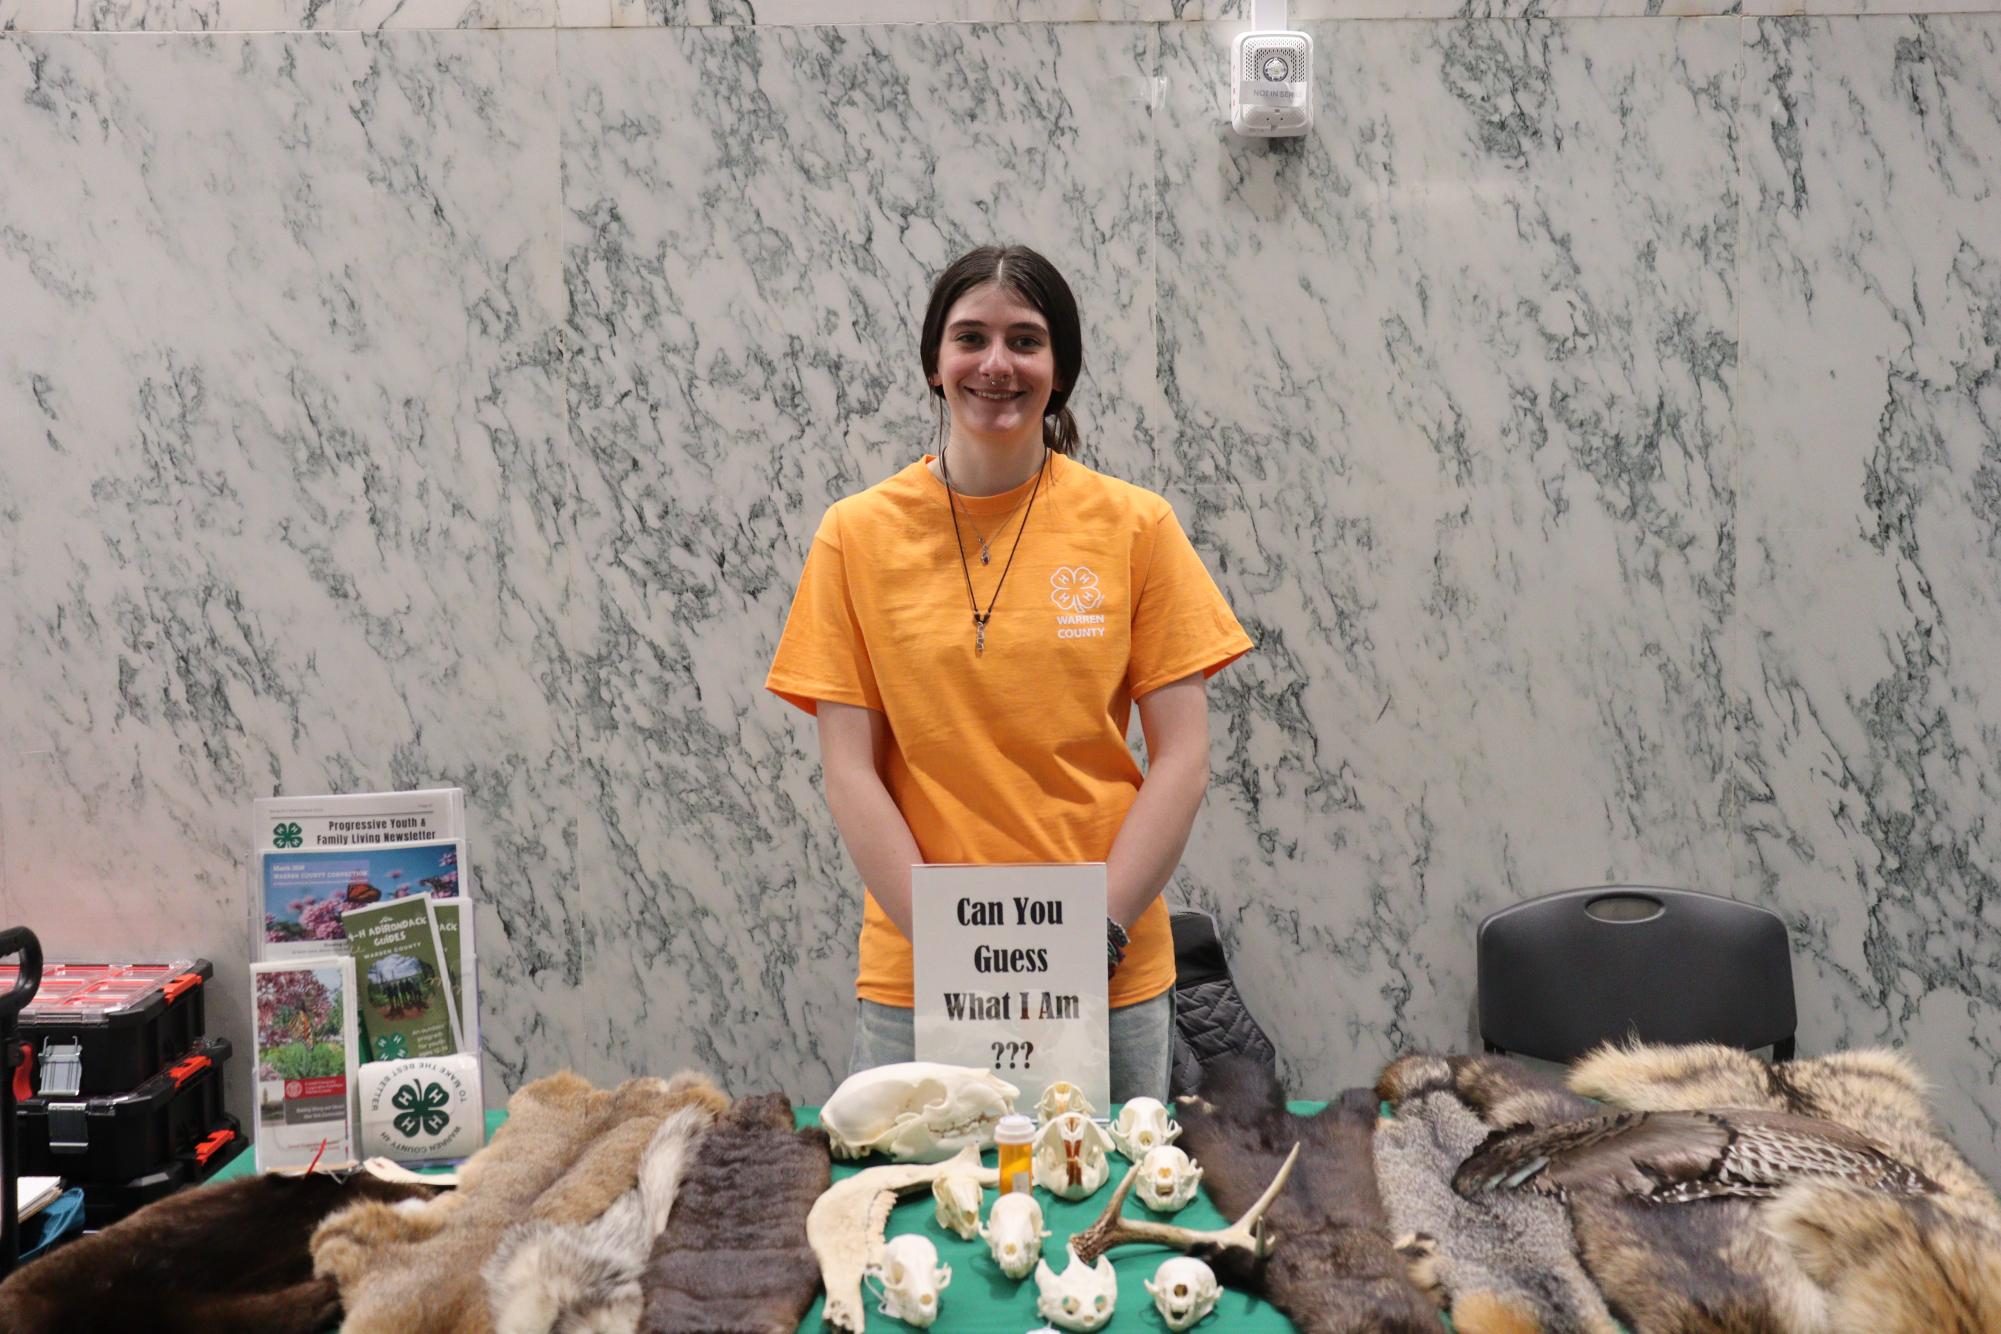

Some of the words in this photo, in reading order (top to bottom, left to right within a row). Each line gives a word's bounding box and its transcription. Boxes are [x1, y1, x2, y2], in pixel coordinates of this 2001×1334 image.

[1056, 615, 1104, 625] WARREN
[1057, 627, 1105, 639] COUNTY
[328, 819, 387, 832] Progressive
[390, 817, 417, 829] Youth
[420, 818, 426, 828] &
[317, 834, 348, 846] Family
[351, 833, 380, 844] Living
[383, 831, 436, 842] Newsletter
[300, 871, 326, 879] COUNTY
[957, 897, 1004, 926] Can
[1013, 897, 1063, 925] You
[348, 928, 366, 942] 4-H
[364, 948, 392, 959] WARREN
[393, 942, 421, 953] COUNTY
[974, 945, 1048, 973] Guess
[944, 992, 1011, 1020] What
[1019, 992, 1030, 1020] I
[1038, 992, 1080, 1020] Am
[991, 1041, 1034, 1070] ???
[392, 1063, 415, 1077] BEST
[419, 1062, 437, 1071] THE
[439, 1068, 462, 1089] MAKE
[371, 1075, 391, 1112] BETTER
[458, 1089, 468, 1103] TO
[380, 1131, 391, 1142] 4H
[429, 1125, 462, 1151] WARREN
[391, 1143, 428, 1154] COUNTY
